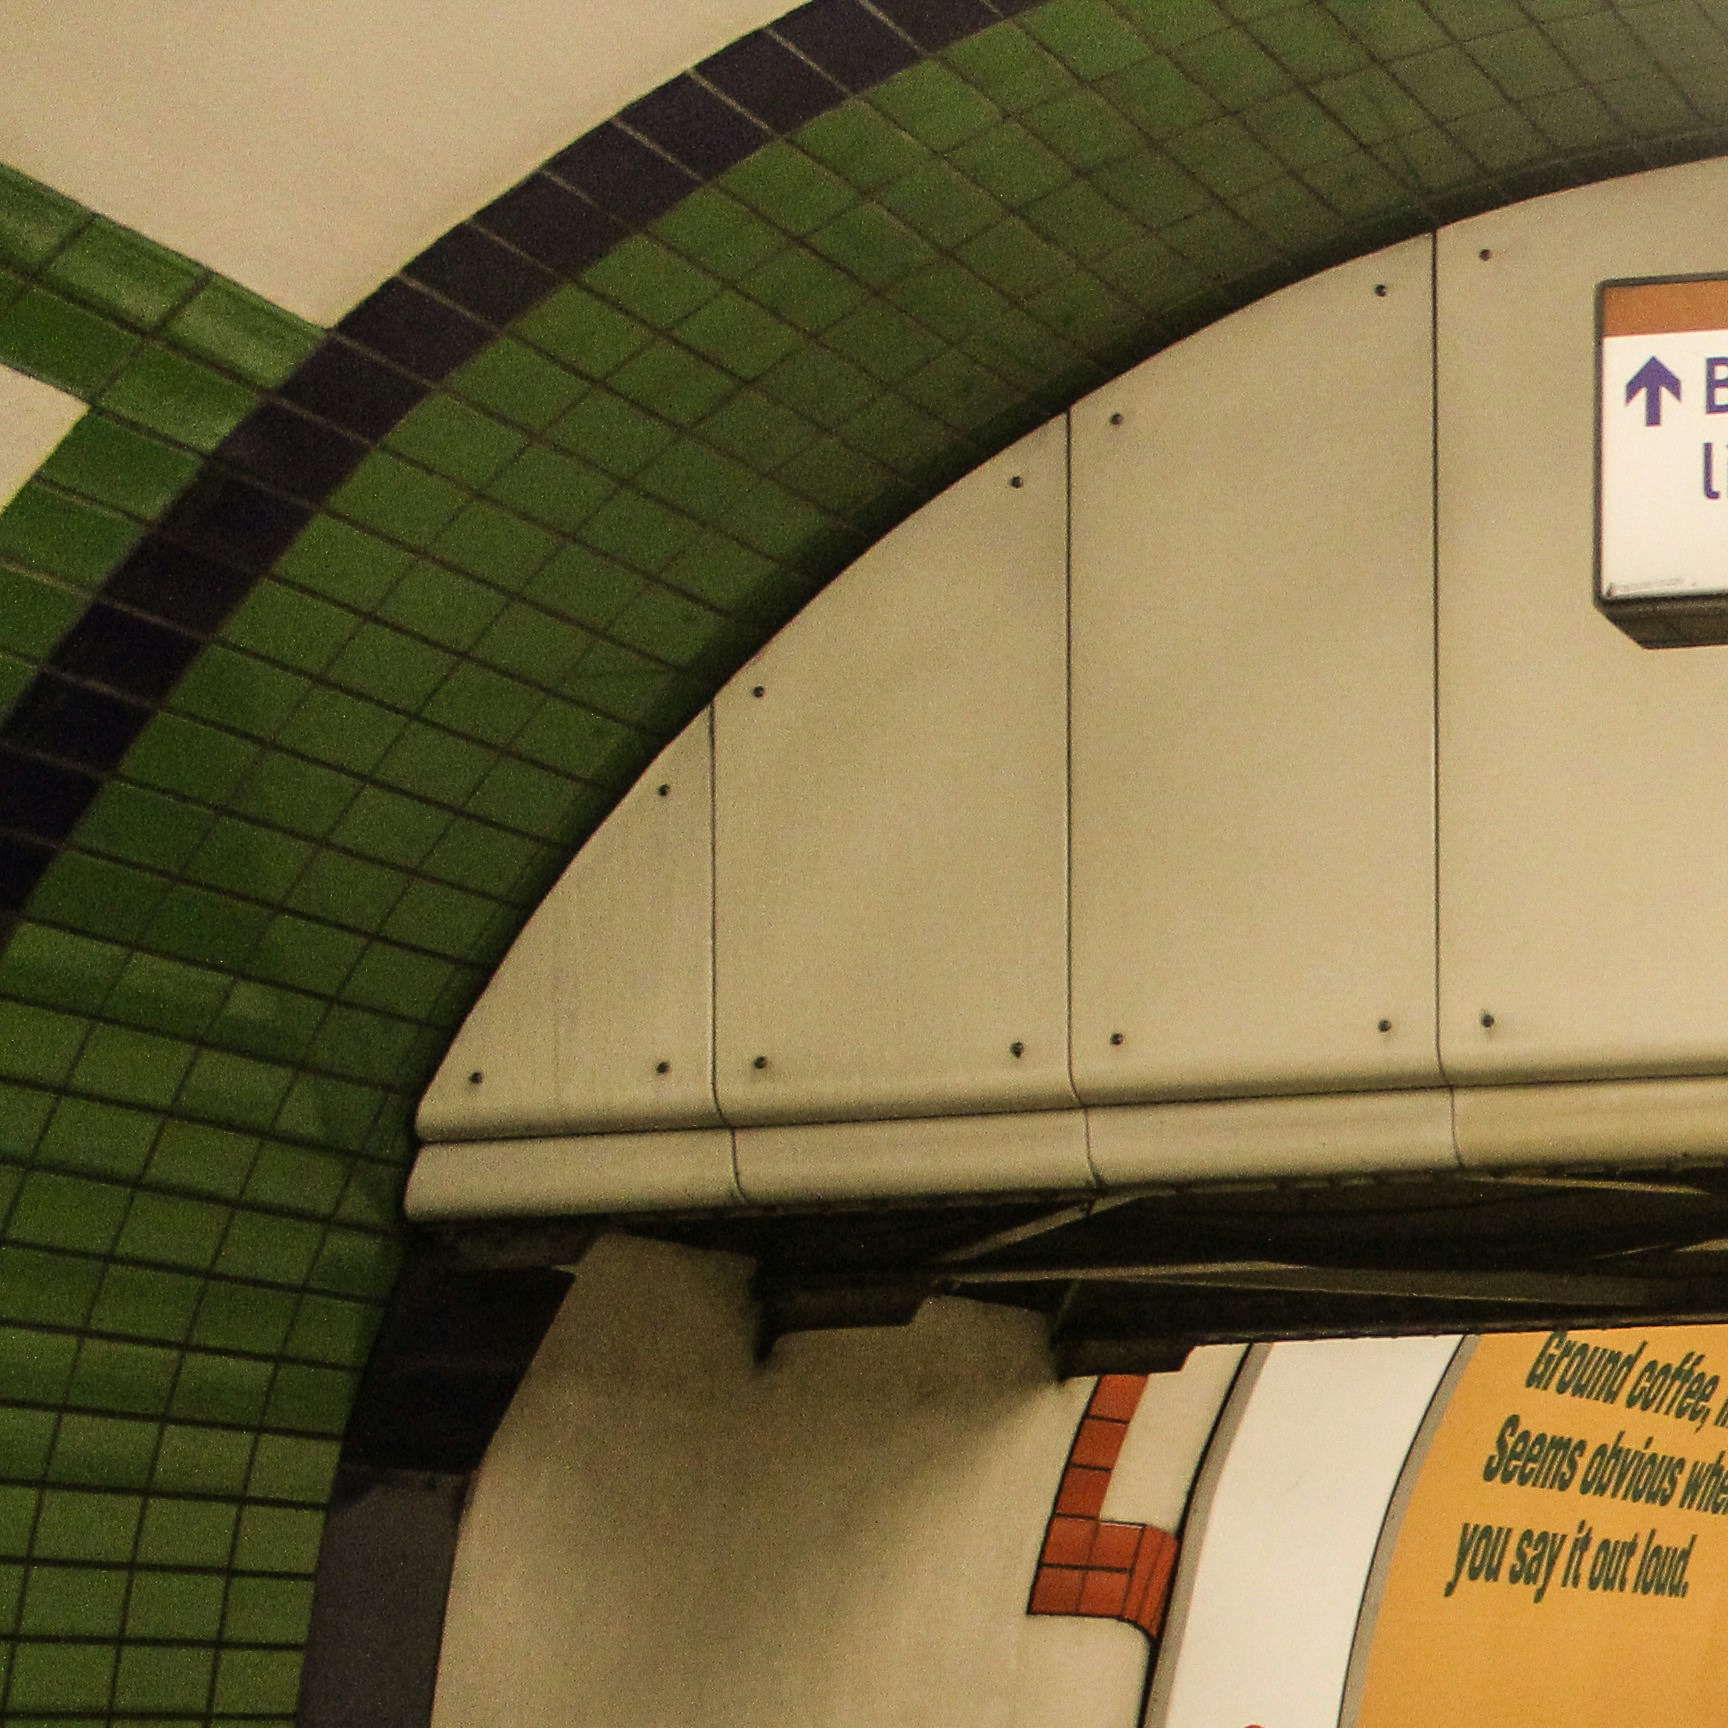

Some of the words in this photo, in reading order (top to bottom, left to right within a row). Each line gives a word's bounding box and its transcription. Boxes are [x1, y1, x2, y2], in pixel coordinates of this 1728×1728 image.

[1525, 1330, 1646, 1408] Ground
[1632, 1351, 1720, 1432] coffee,
[1482, 1413, 1587, 1493] Seems
[1580, 1429, 1686, 1509] obvious
[1444, 1520, 1513, 1598] you
[1508, 1526, 1566, 1603] say
[1560, 1519, 1591, 1590] it
[1589, 1528, 1638, 1592] out
[1633, 1527, 1698, 1599] loud.
